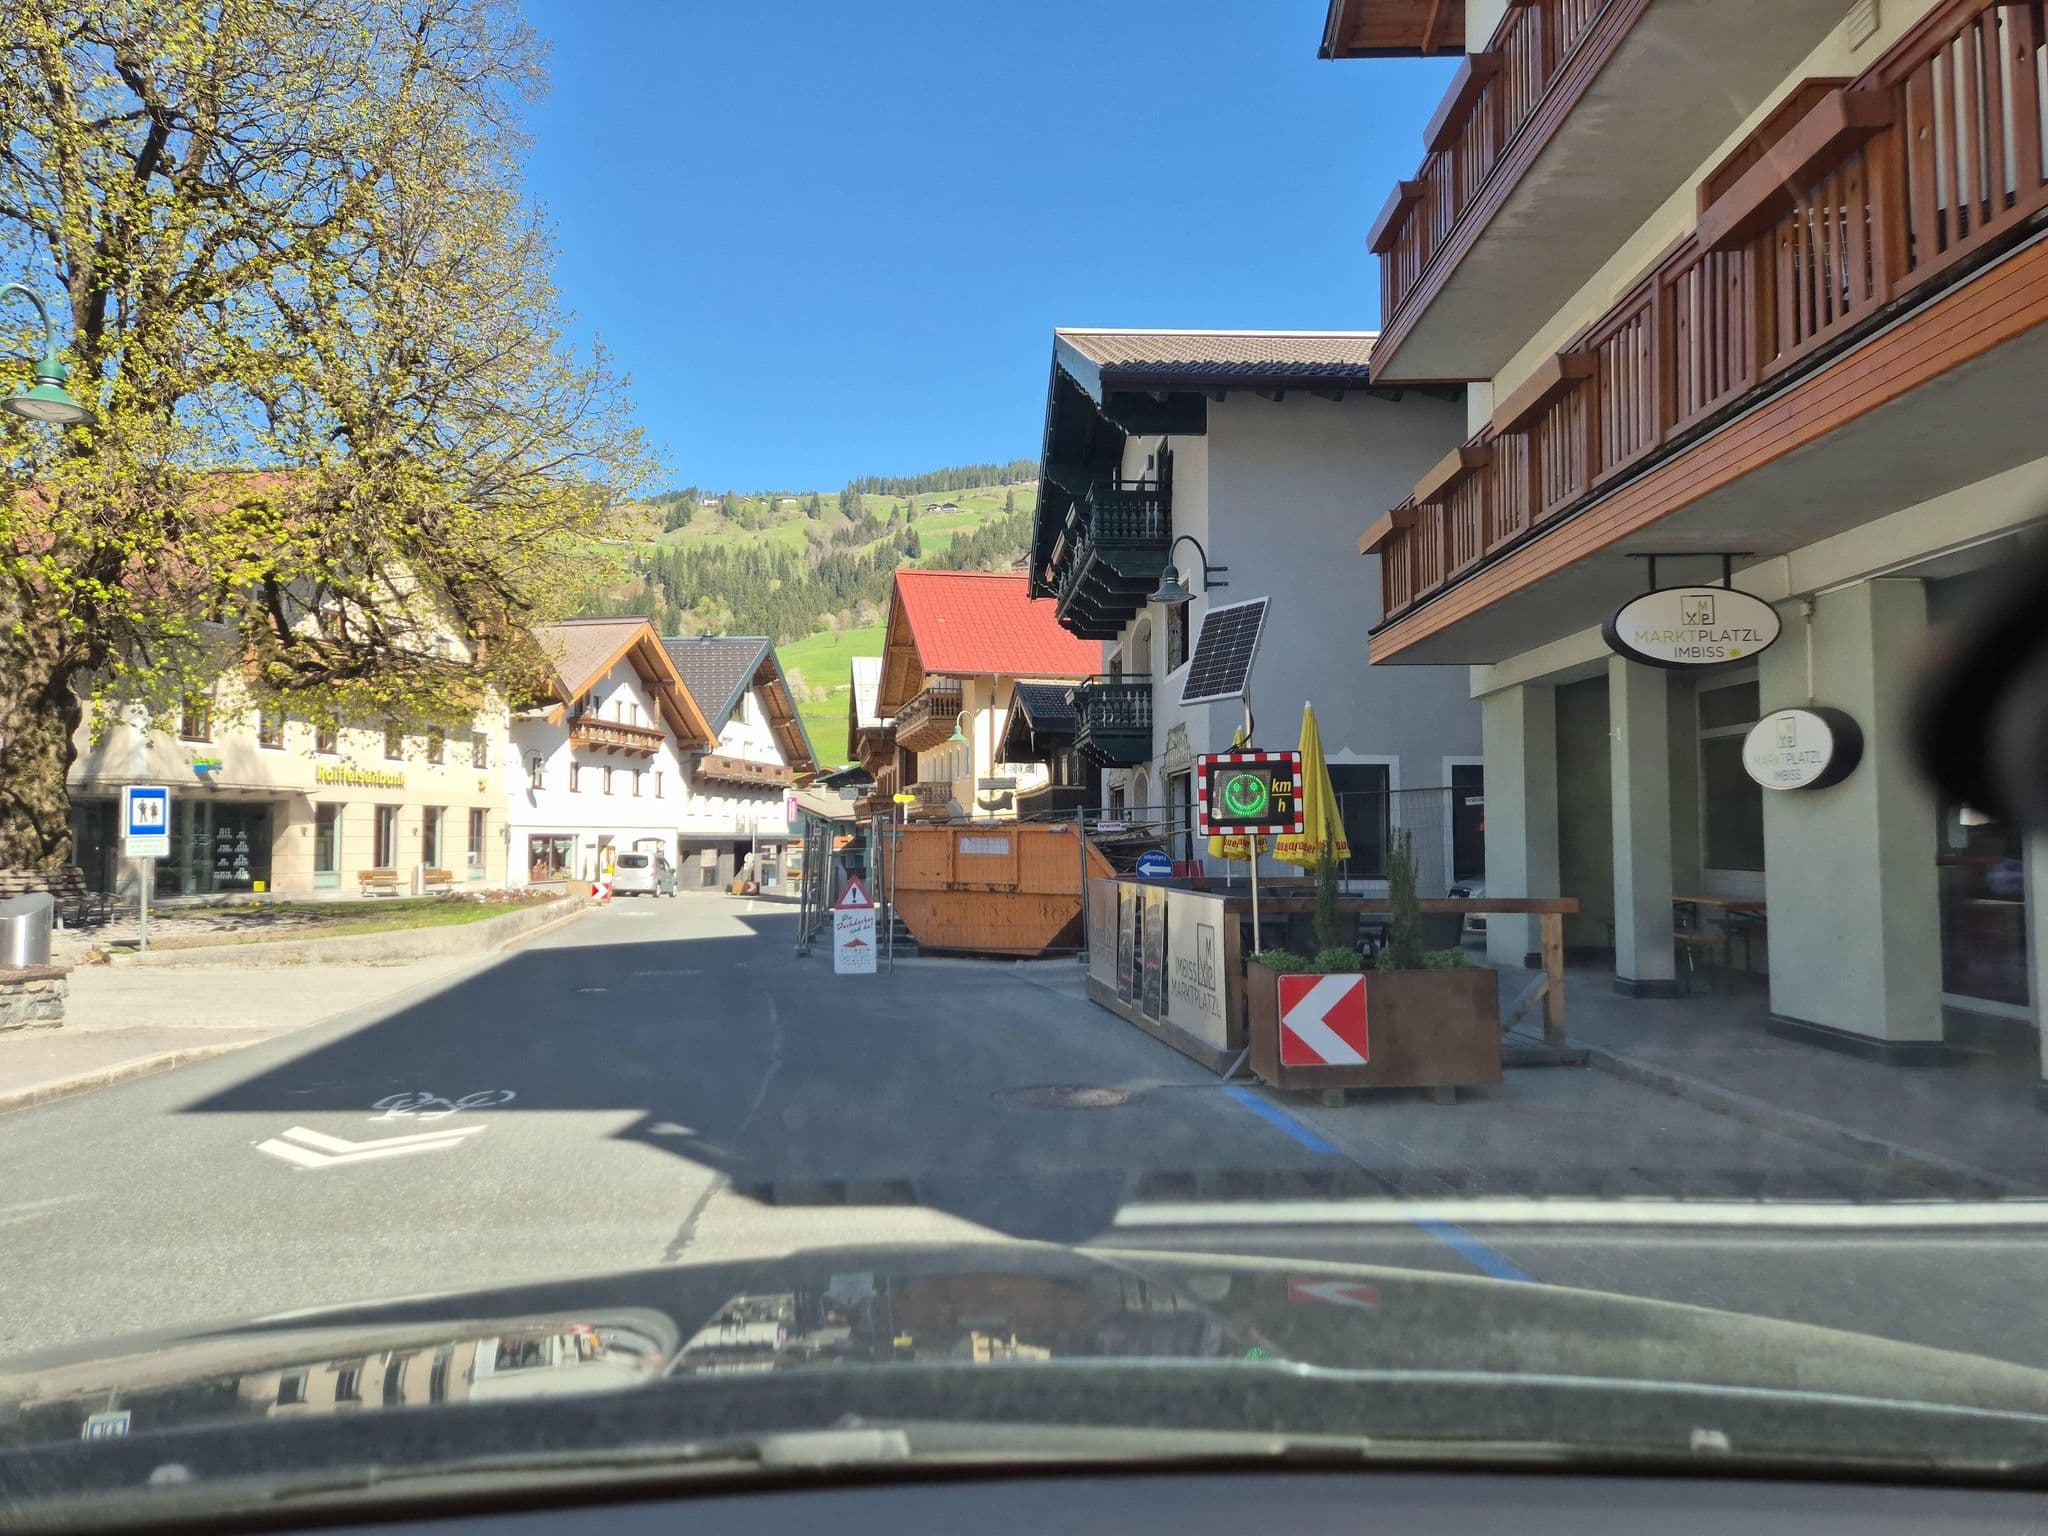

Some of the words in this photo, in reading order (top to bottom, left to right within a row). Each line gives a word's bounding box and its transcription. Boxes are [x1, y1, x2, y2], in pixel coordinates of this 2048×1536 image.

[1634, 628, 1763, 644] MARKTPLATZL
[1673, 646, 1725, 659] IMBISS
[317, 764, 406, 786] Raiffeisenbank
[1271, 778, 1292, 793] km
[1277, 798, 1286, 813] h
[1175, 955, 1197, 983] IMBISS
[1171, 977, 1222, 1019] MARKTPLATZL
